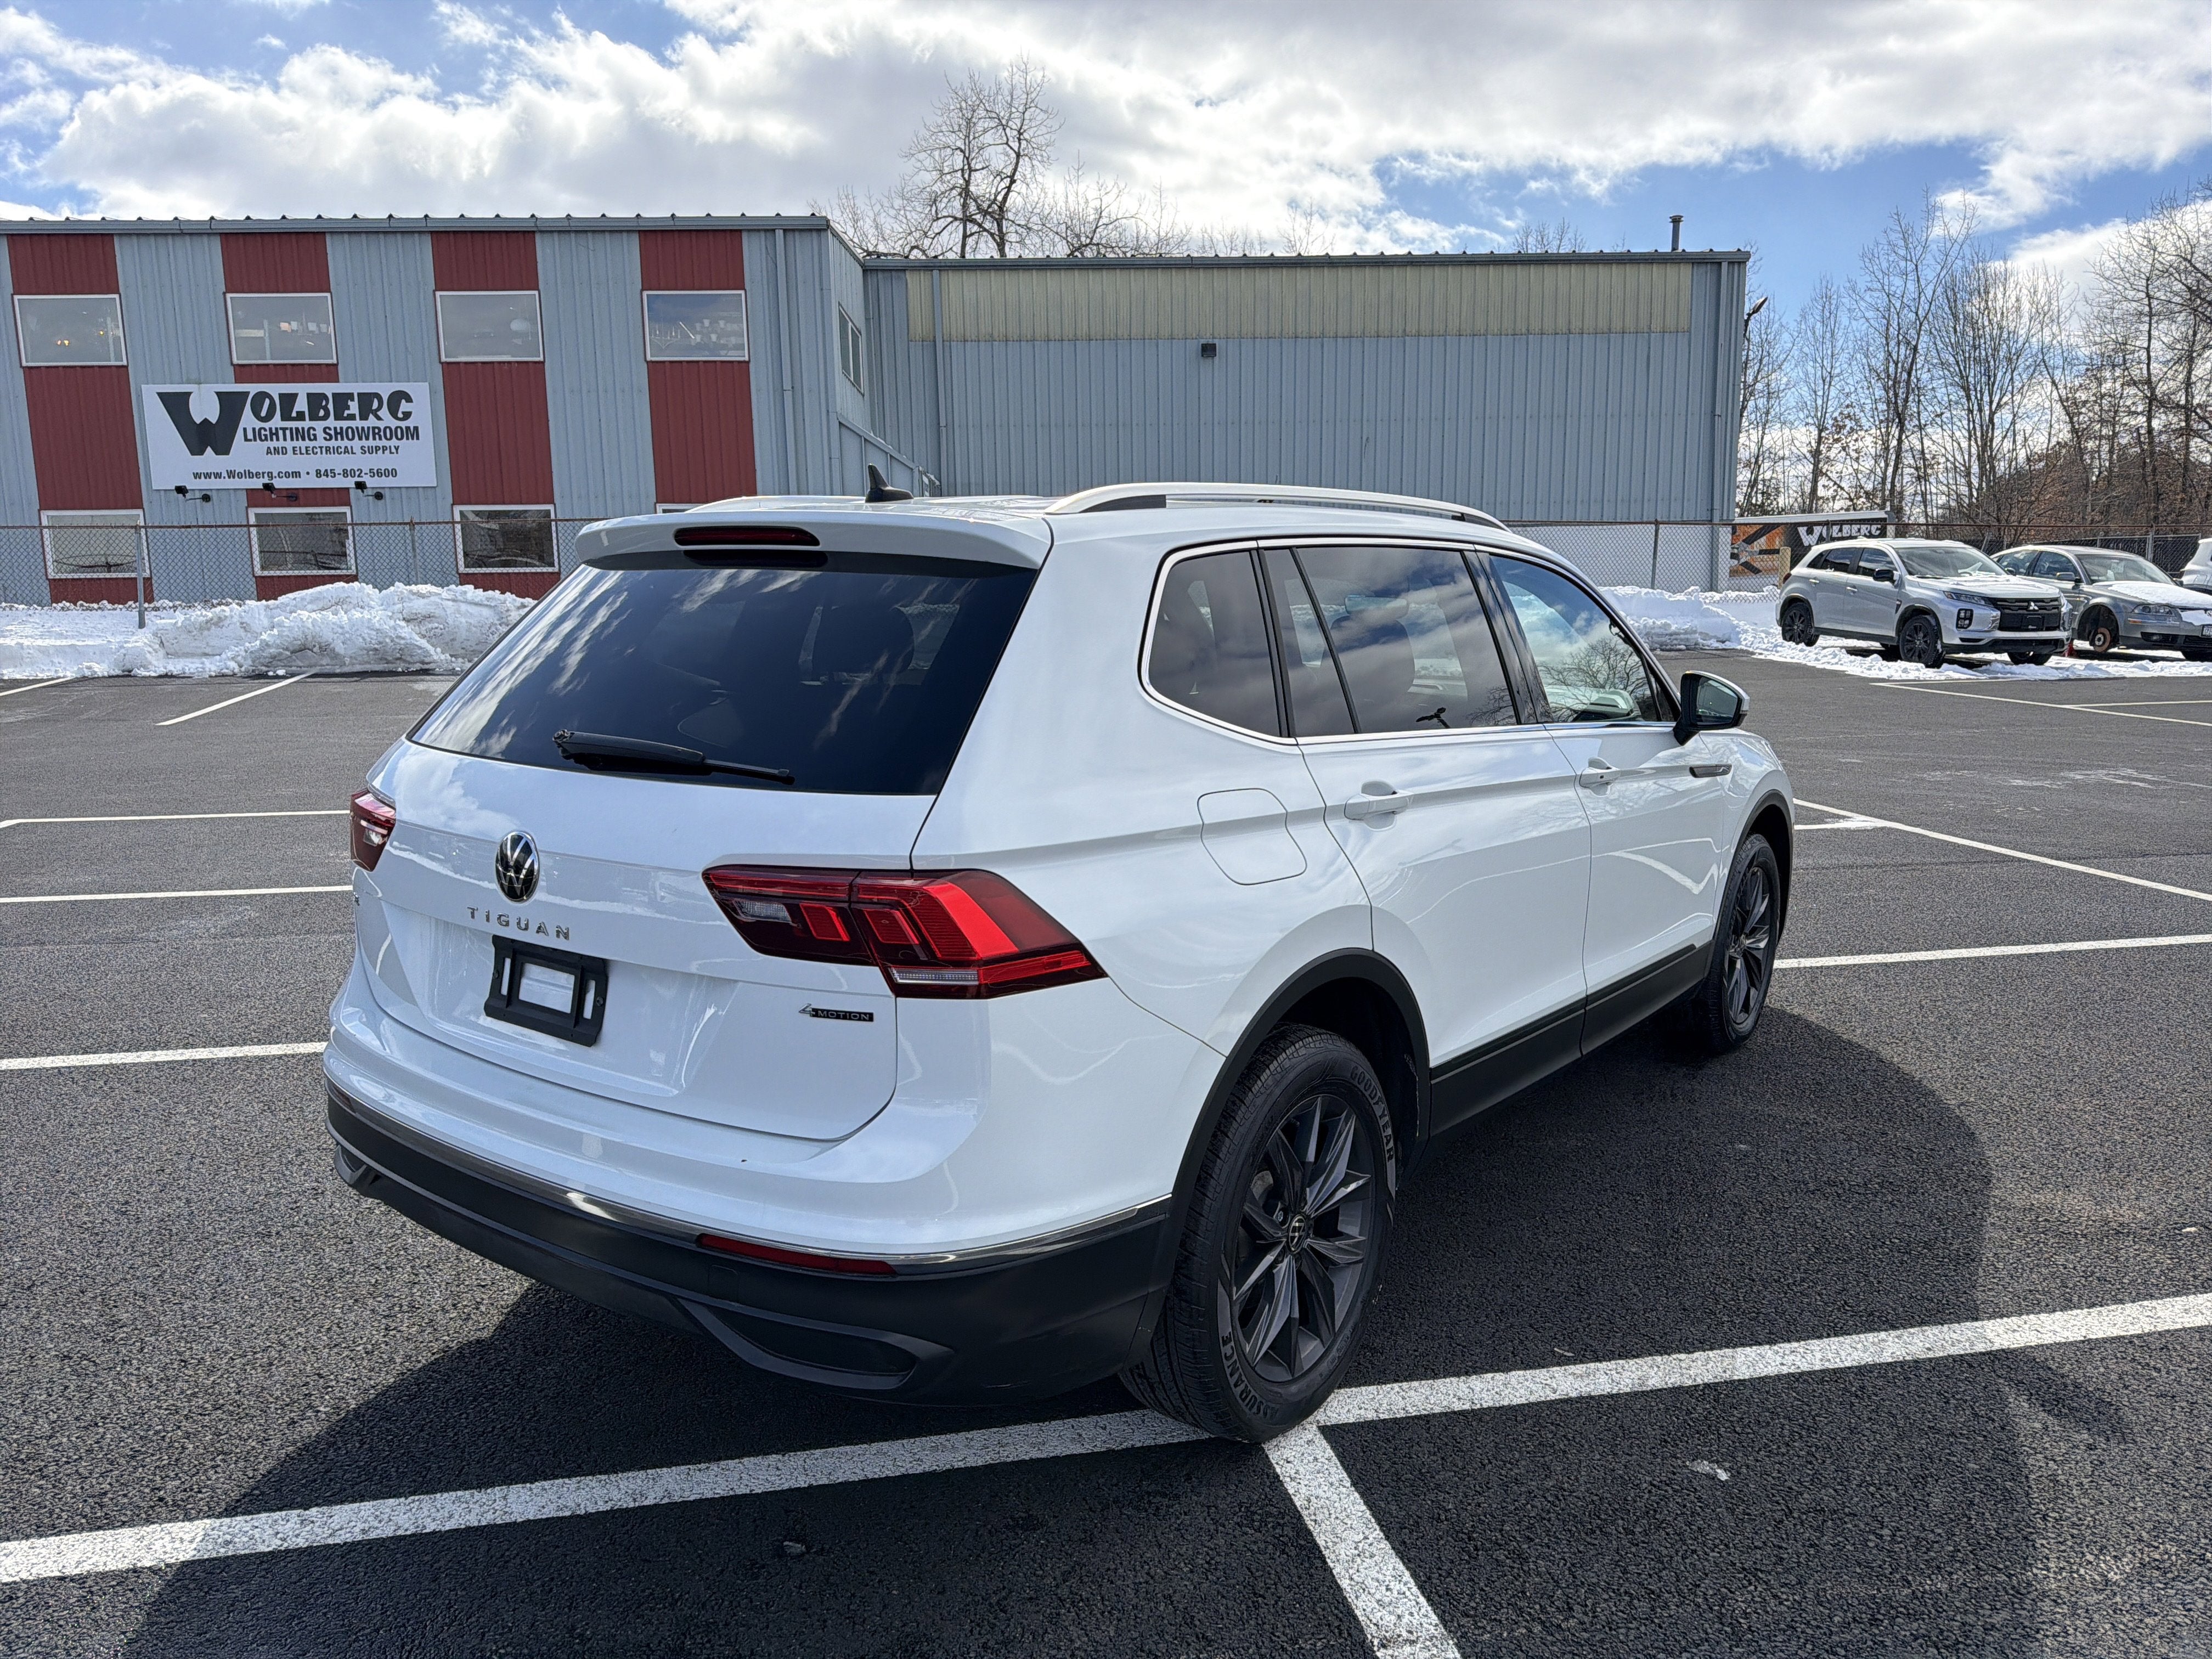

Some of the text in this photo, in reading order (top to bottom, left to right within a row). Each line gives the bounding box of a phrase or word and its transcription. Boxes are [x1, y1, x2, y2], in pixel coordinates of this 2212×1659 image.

[156, 390, 414, 456] WOLBERG
[242, 426, 420, 442] LIGHTING SHOWROOM
[266, 445, 400, 456] AND ELECTRICAL SUPPLY
[193, 468, 398, 481] www.Wolberg.com 845-802-5600
[466, 905, 570, 941] TIGUAN
[799, 1003, 870, 1021] 4MOTION
[1350, 1065, 1394, 1164] GOODYEAR
[1221, 1331, 1279, 1420] ASSURANCE
